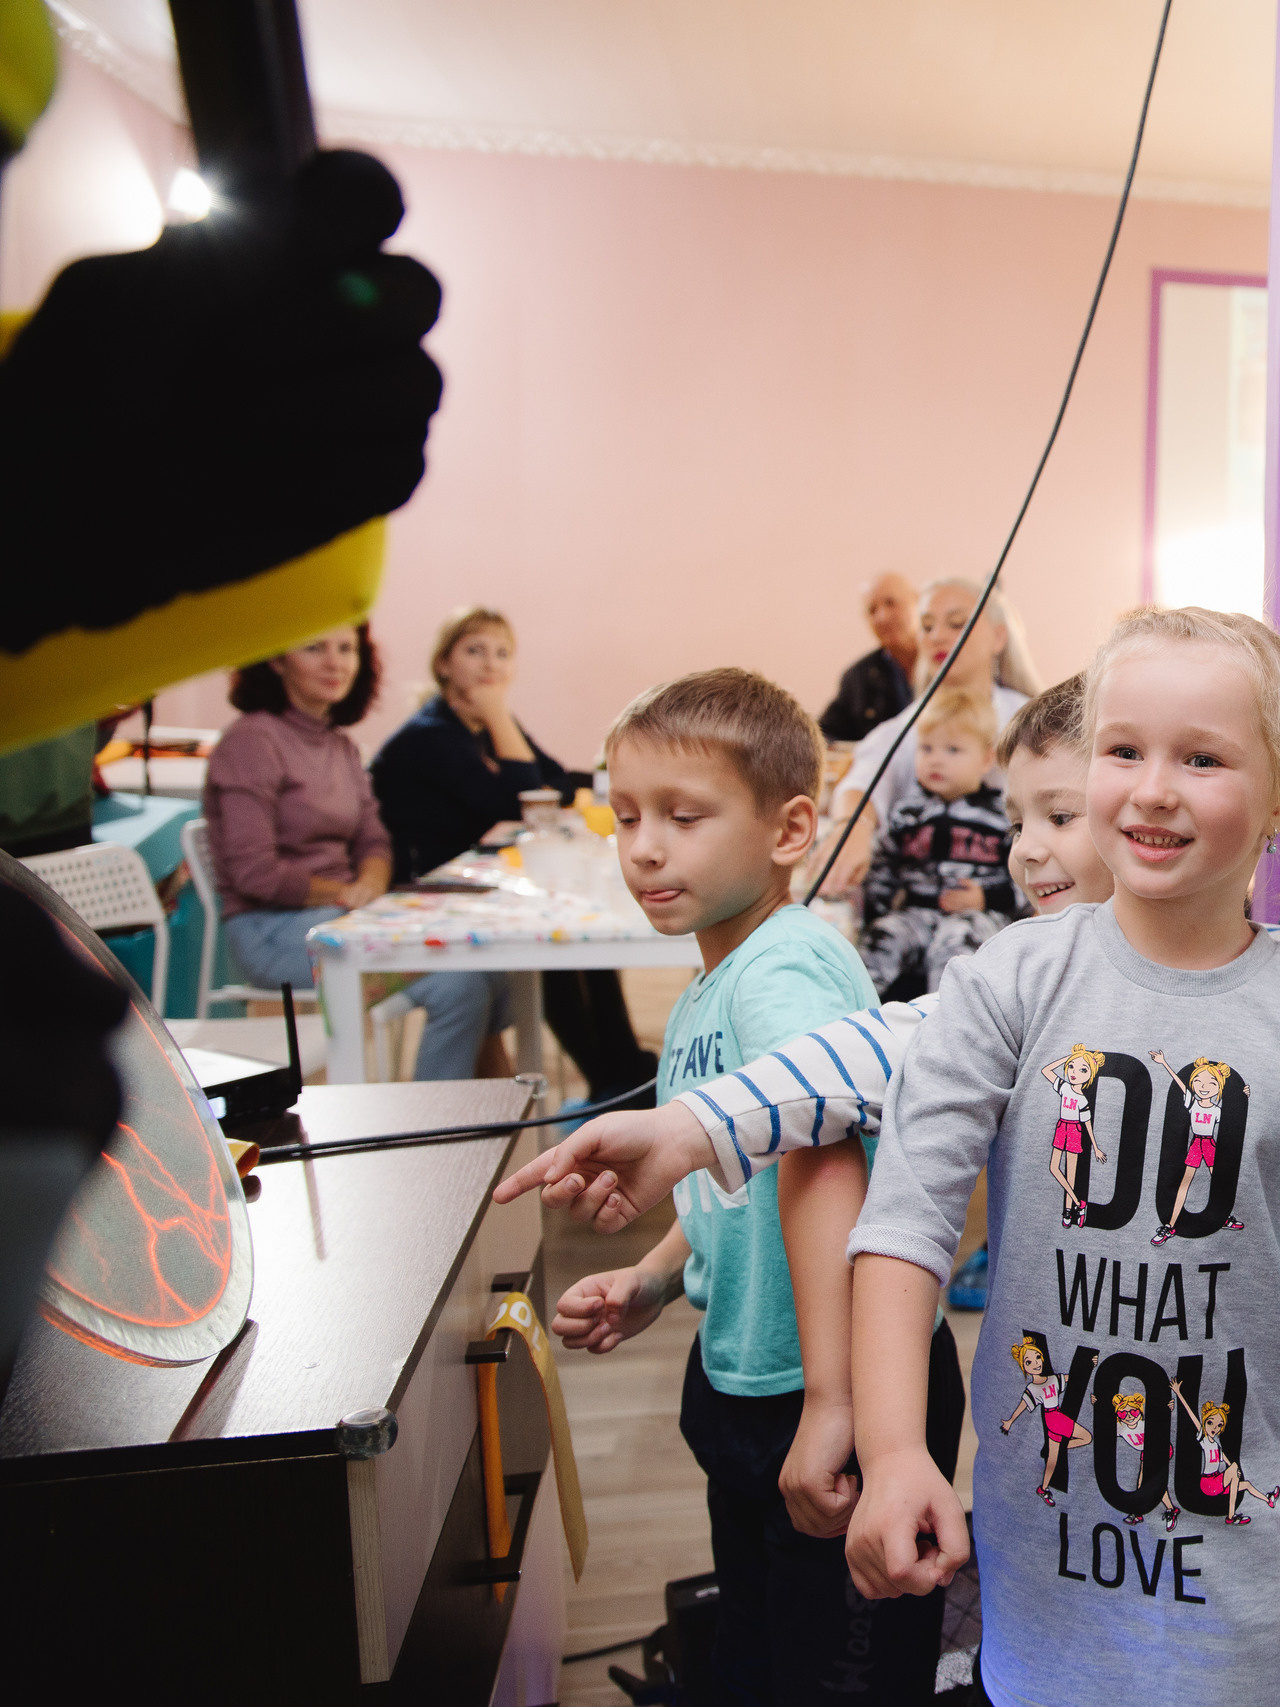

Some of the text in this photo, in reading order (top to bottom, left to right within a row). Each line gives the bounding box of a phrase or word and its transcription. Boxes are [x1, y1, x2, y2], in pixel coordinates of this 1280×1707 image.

[682, 1031, 724, 1079] AVE
[1063, 1049, 1250, 1239] DO
[1056, 1248, 1231, 1343] WHAT
[1021, 1328, 1248, 1518] YOU
[1057, 1511, 1207, 1604] LOVE
